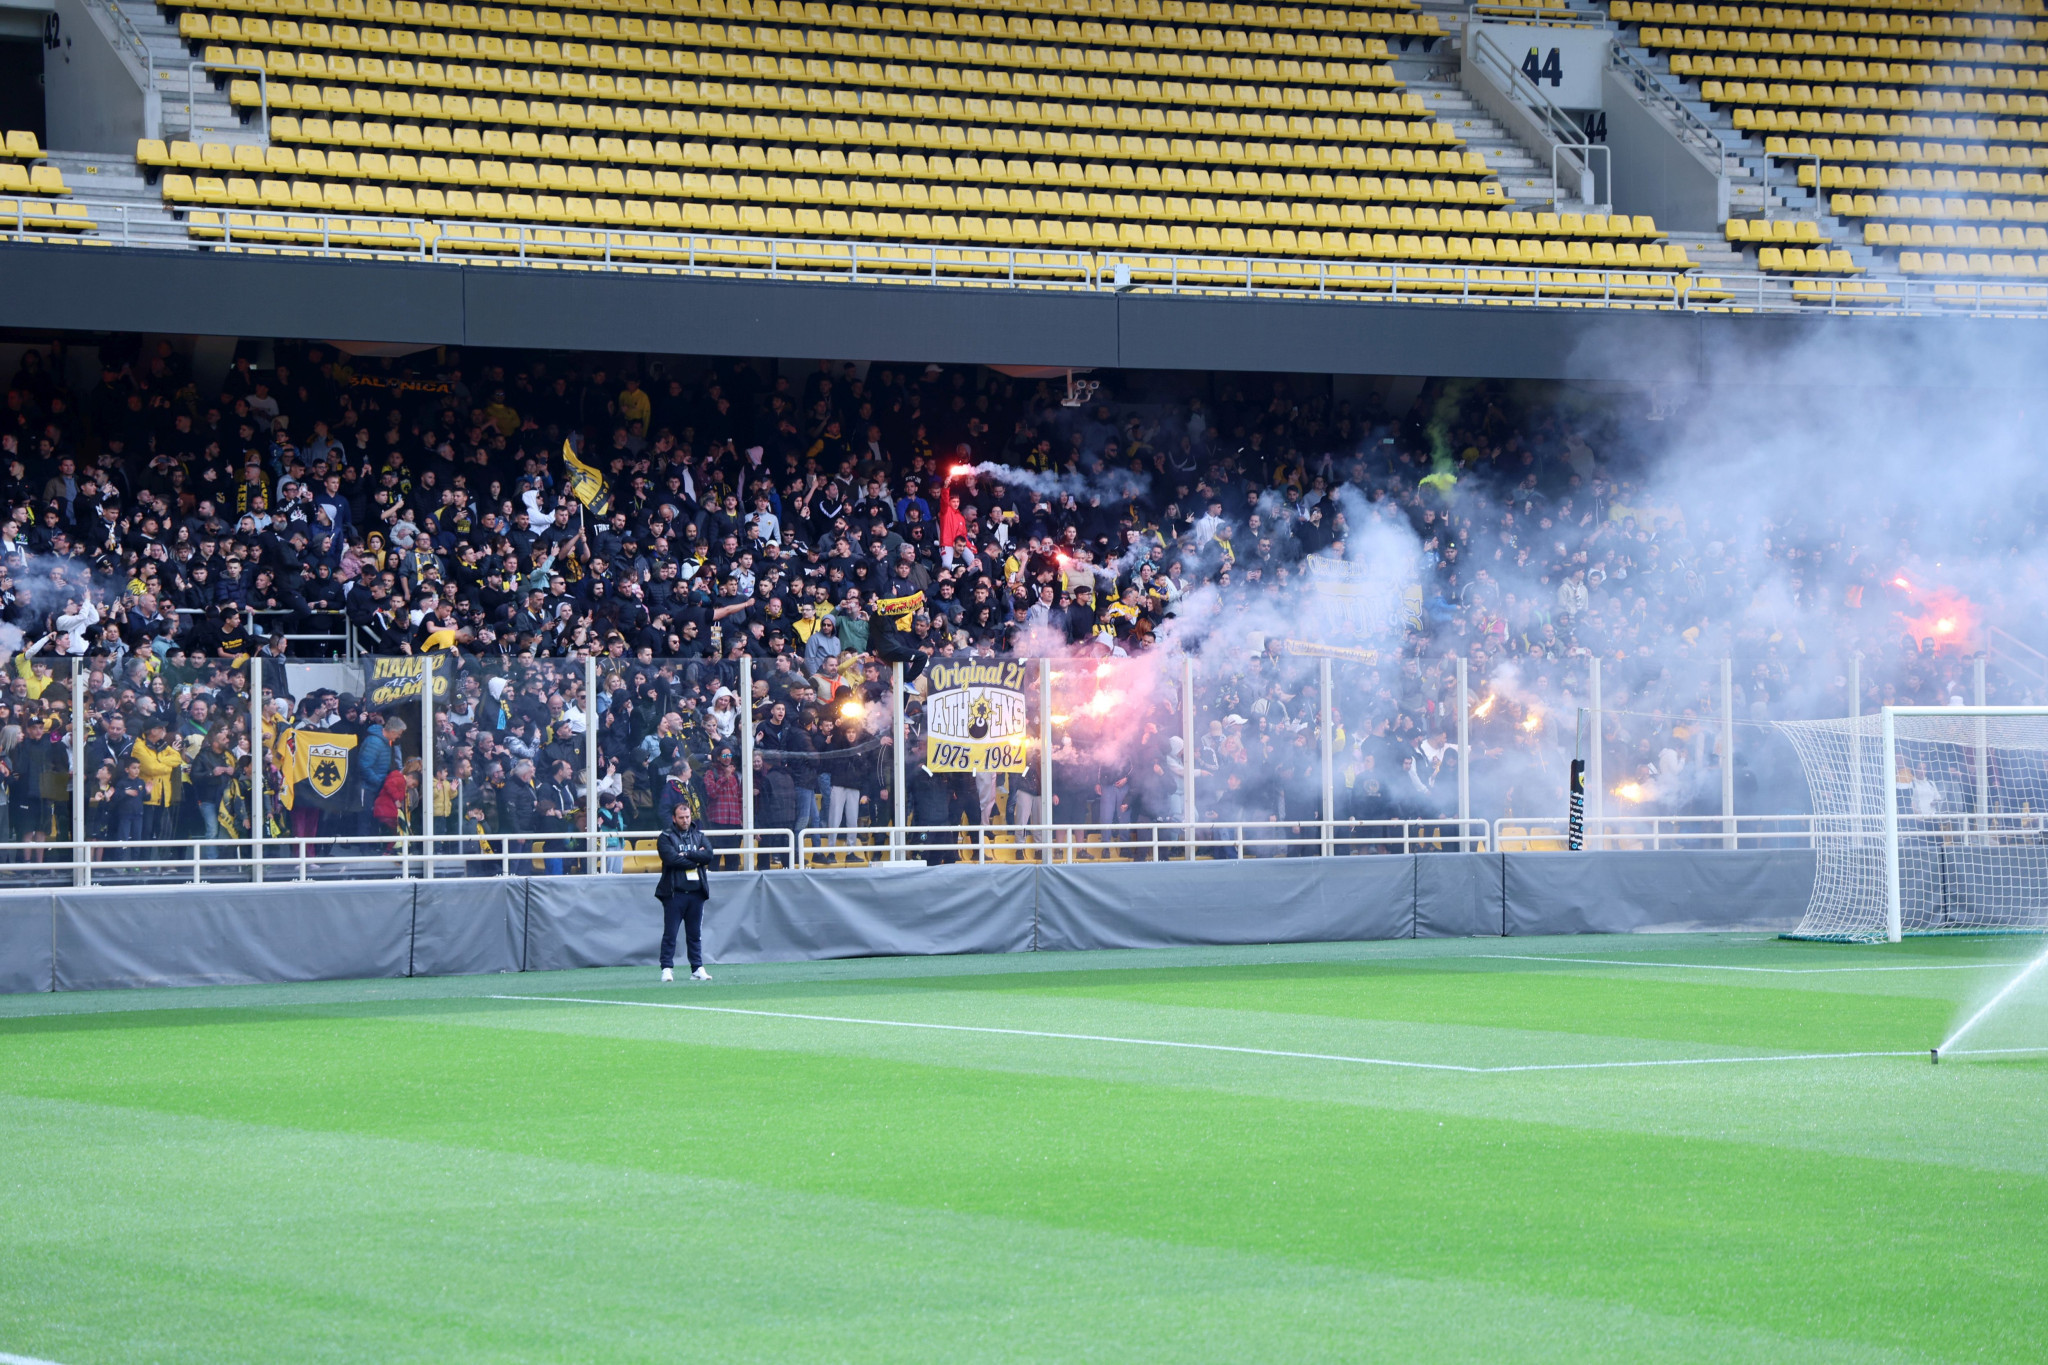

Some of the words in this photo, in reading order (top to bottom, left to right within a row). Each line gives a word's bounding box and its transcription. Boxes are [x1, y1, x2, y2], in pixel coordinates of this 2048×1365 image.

[44, 12, 60, 50] 42
[1520, 47, 1563, 87] 44
[1584, 111, 1607, 144] 44
[372, 654, 446, 679] ΠΑΛΑΟ
[930, 660, 1005, 691] Original
[1004, 663, 1026, 690] 21
[372, 675, 448, 705] ΦΑΛΗΟ
[931, 744, 970, 768] 1975
[984, 745, 1023, 770] 1982
